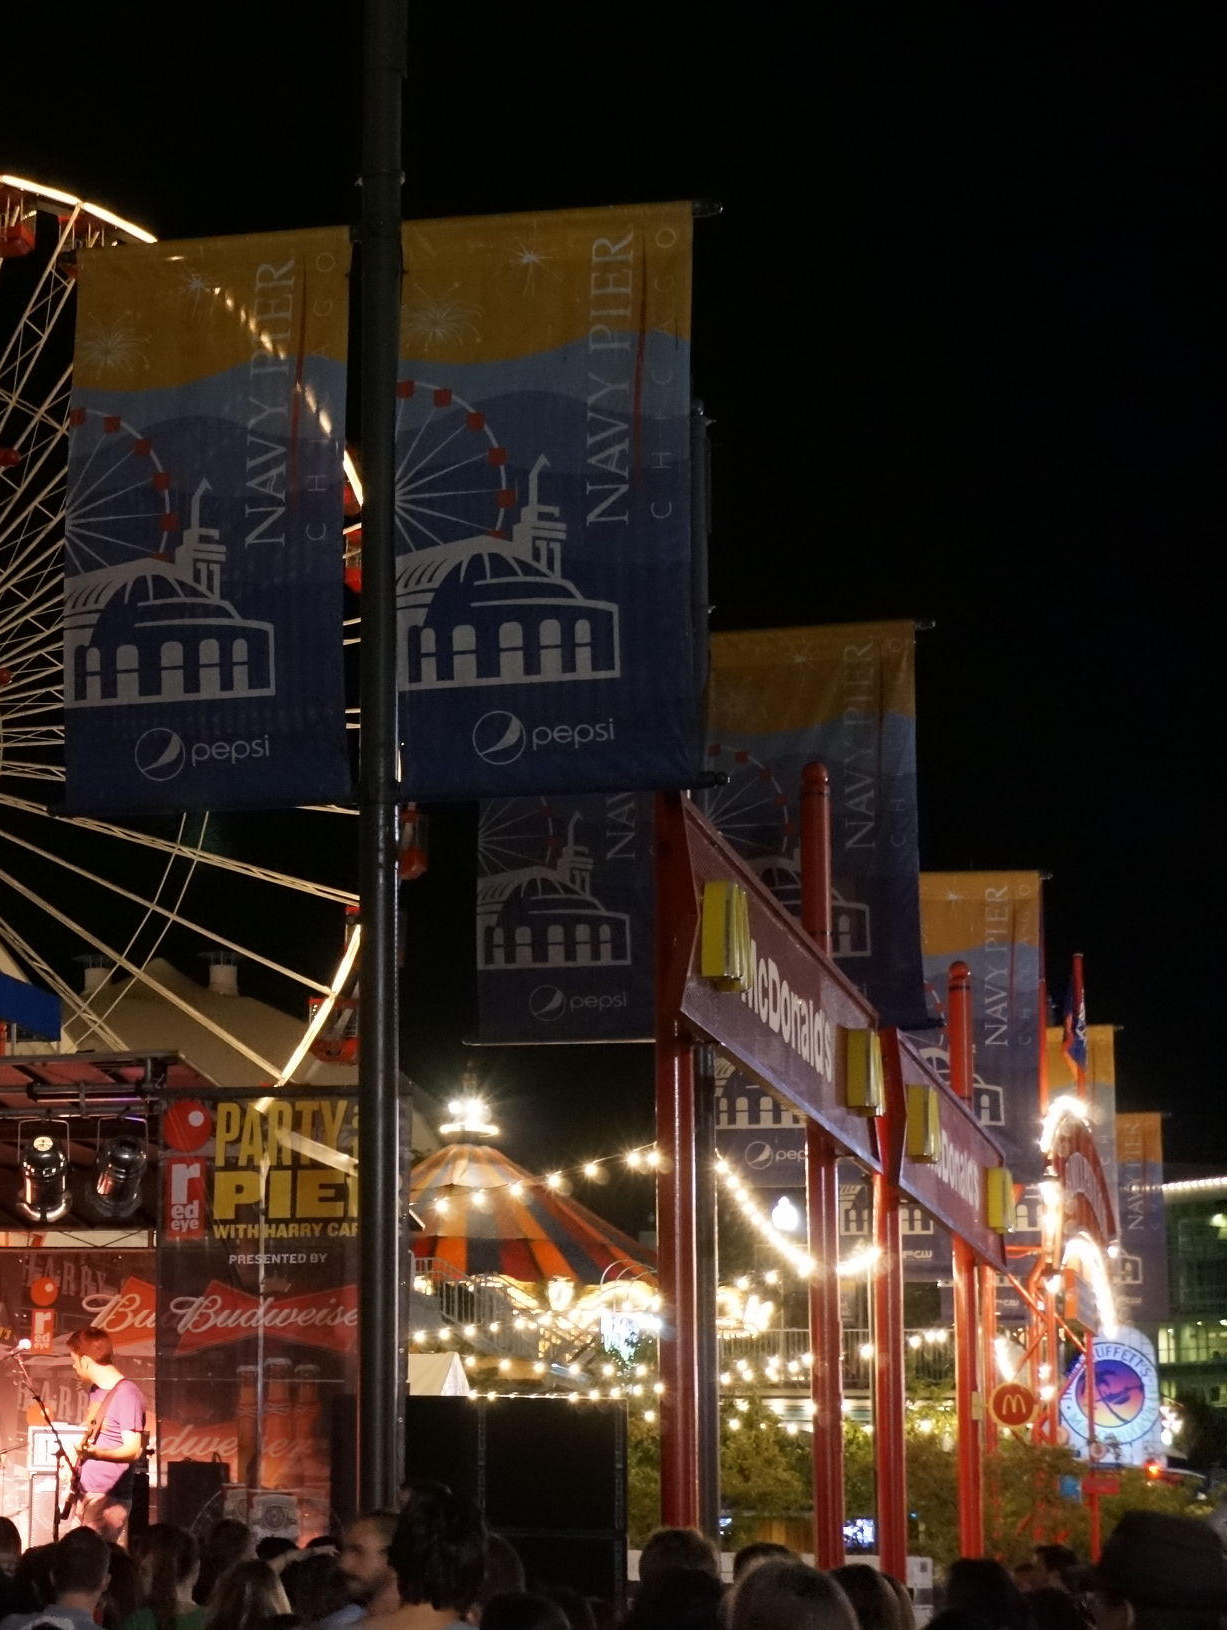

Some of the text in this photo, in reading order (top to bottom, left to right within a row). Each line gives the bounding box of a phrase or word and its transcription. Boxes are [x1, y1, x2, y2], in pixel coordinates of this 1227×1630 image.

[586, 224, 634, 528] NAVY PIER
[244, 256, 295, 549] NAVY PIER
[191, 733, 270, 767] pepsi
[532, 717, 615, 751] pepsi
[844, 636, 876, 850] NAVY PIER
[984, 885, 1009, 1047] NAVY PIER
[570, 992, 628, 1011] pepsi
[214, 1100, 348, 1168] PARTY
[213, 1224, 259, 1239] WITH
[262, 1223, 323, 1238] HARRY
[228, 1253, 328, 1265] PRESENTED BY
[169, 1295, 359, 1335] Budweise
[1093, 1344, 1153, 1378] UFFETT'S
